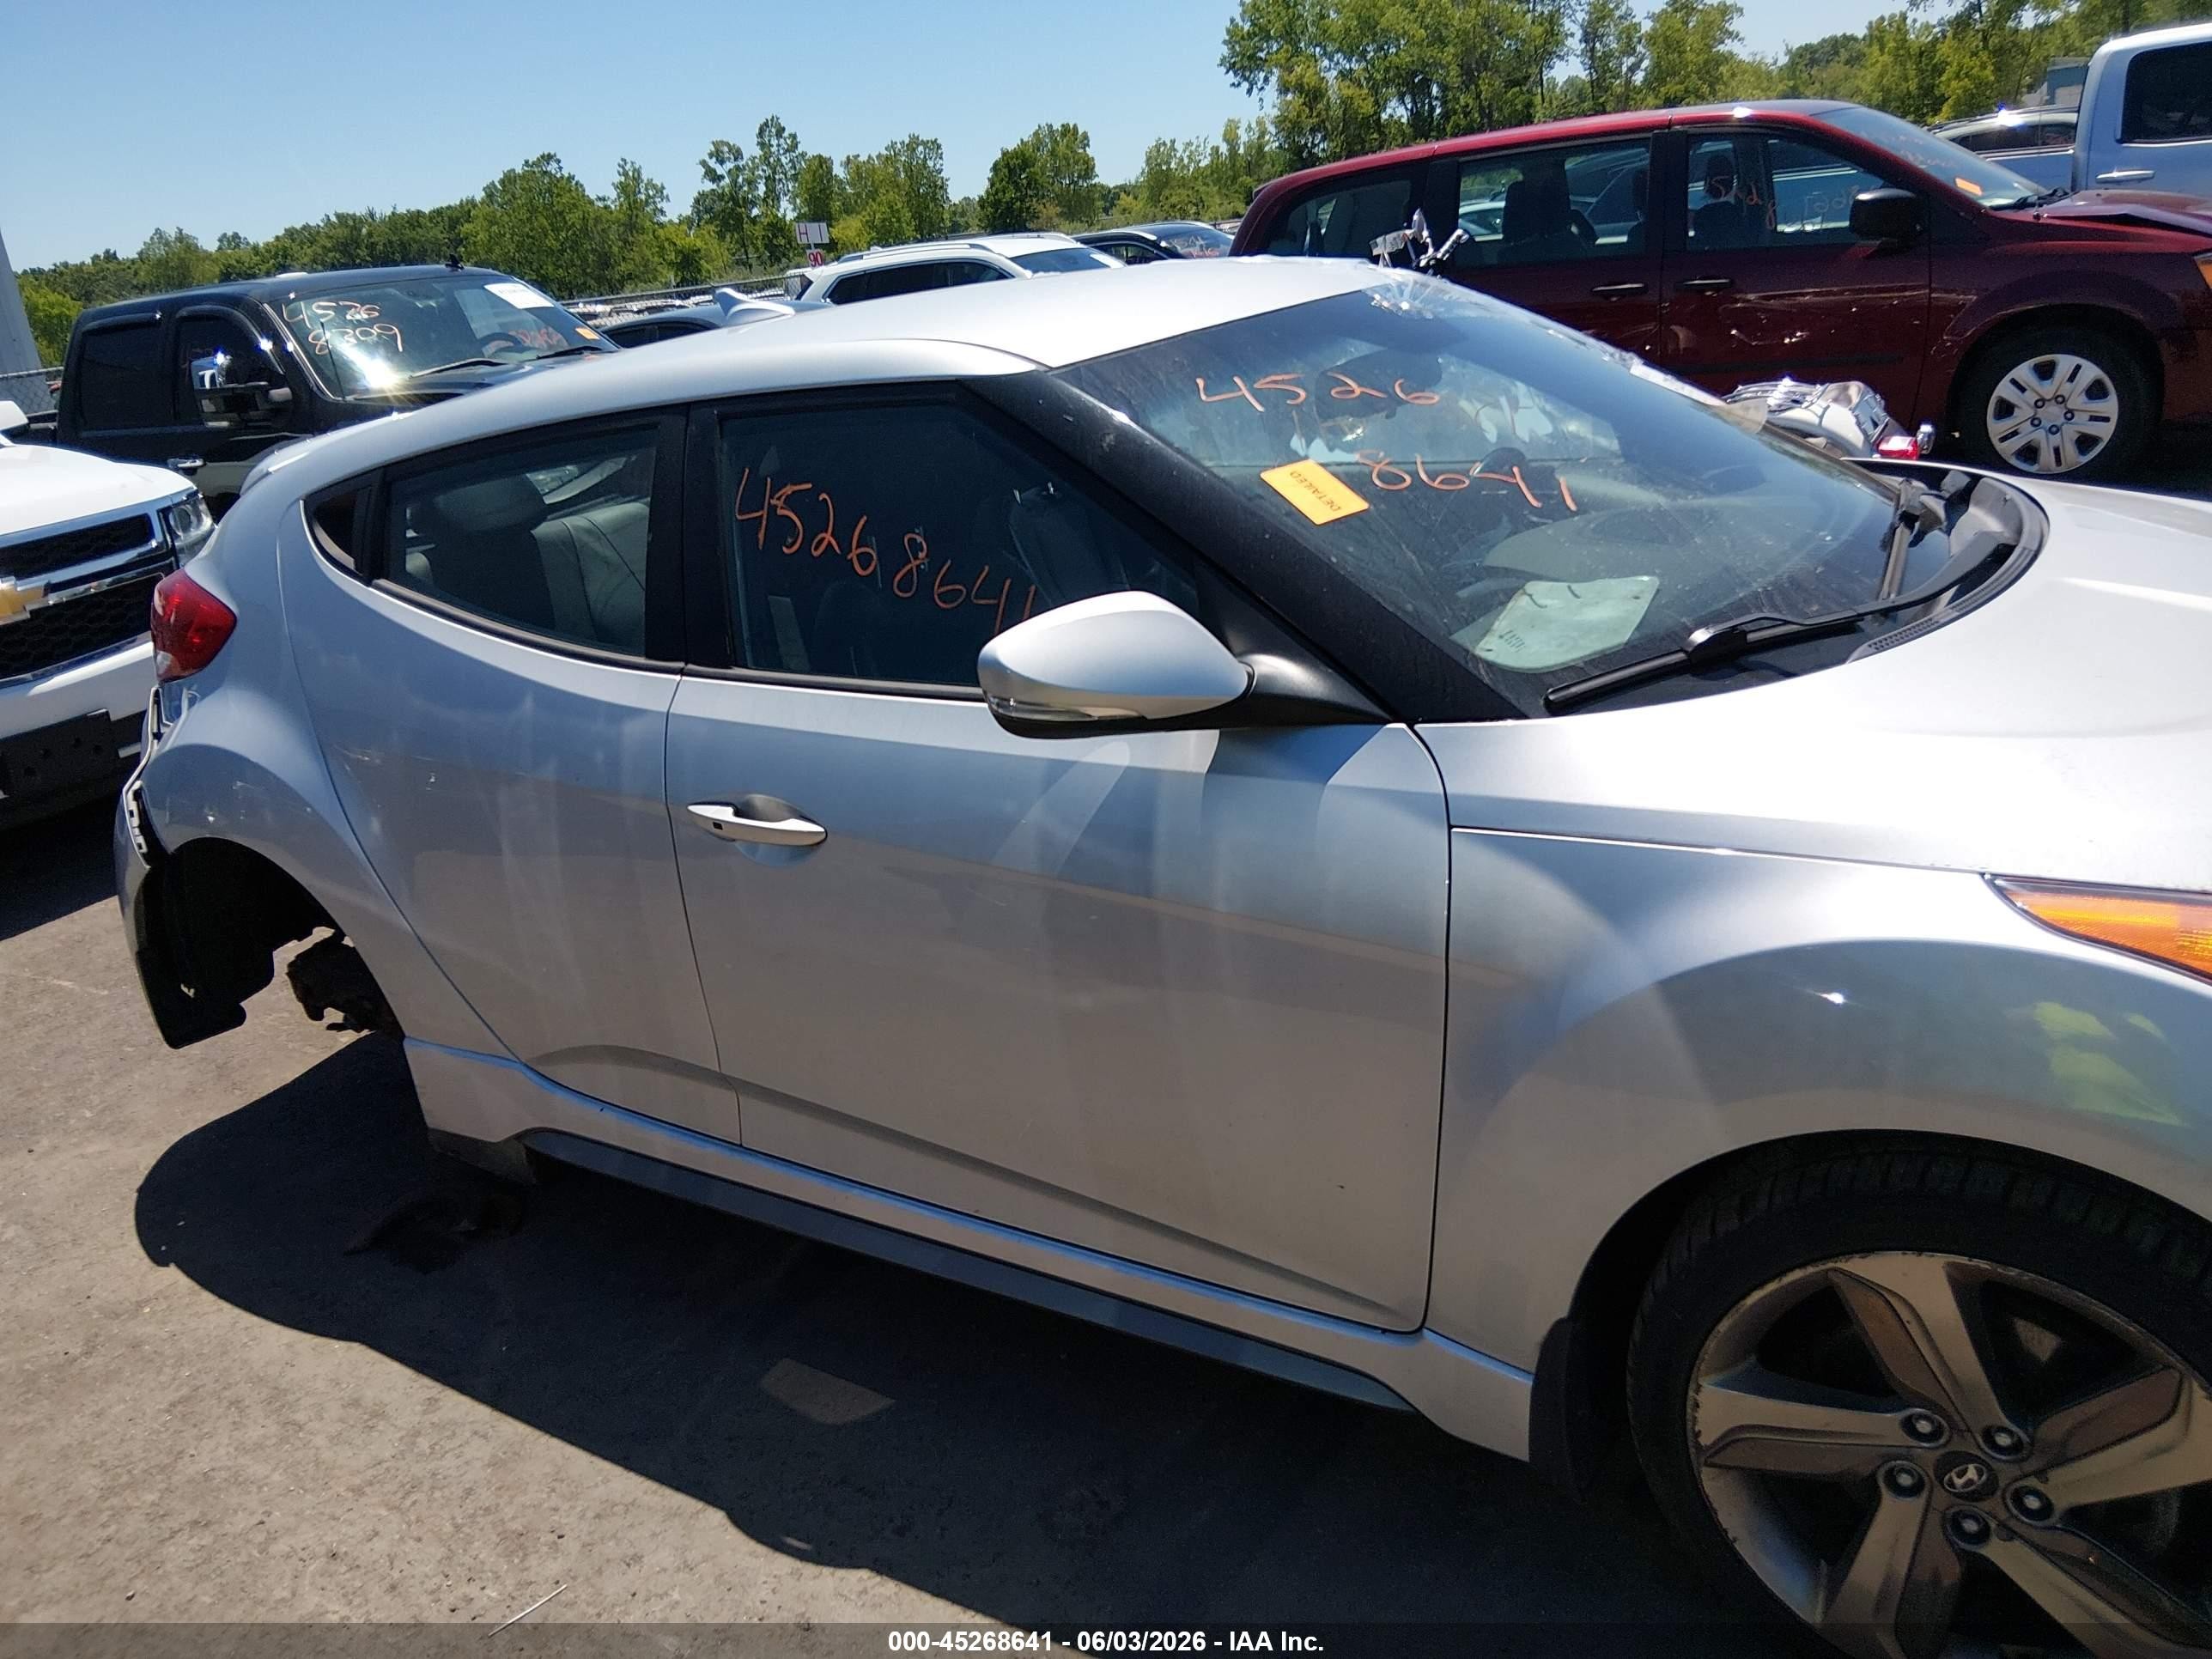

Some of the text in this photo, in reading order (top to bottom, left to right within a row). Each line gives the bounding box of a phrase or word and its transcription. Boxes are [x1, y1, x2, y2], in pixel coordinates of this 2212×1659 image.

[810, 251, 823, 267] 90
[1196, 372, 1441, 413] 4526
[1290, 470, 1341, 512] DETAILED
[1356, 449, 1577, 512] 8641
